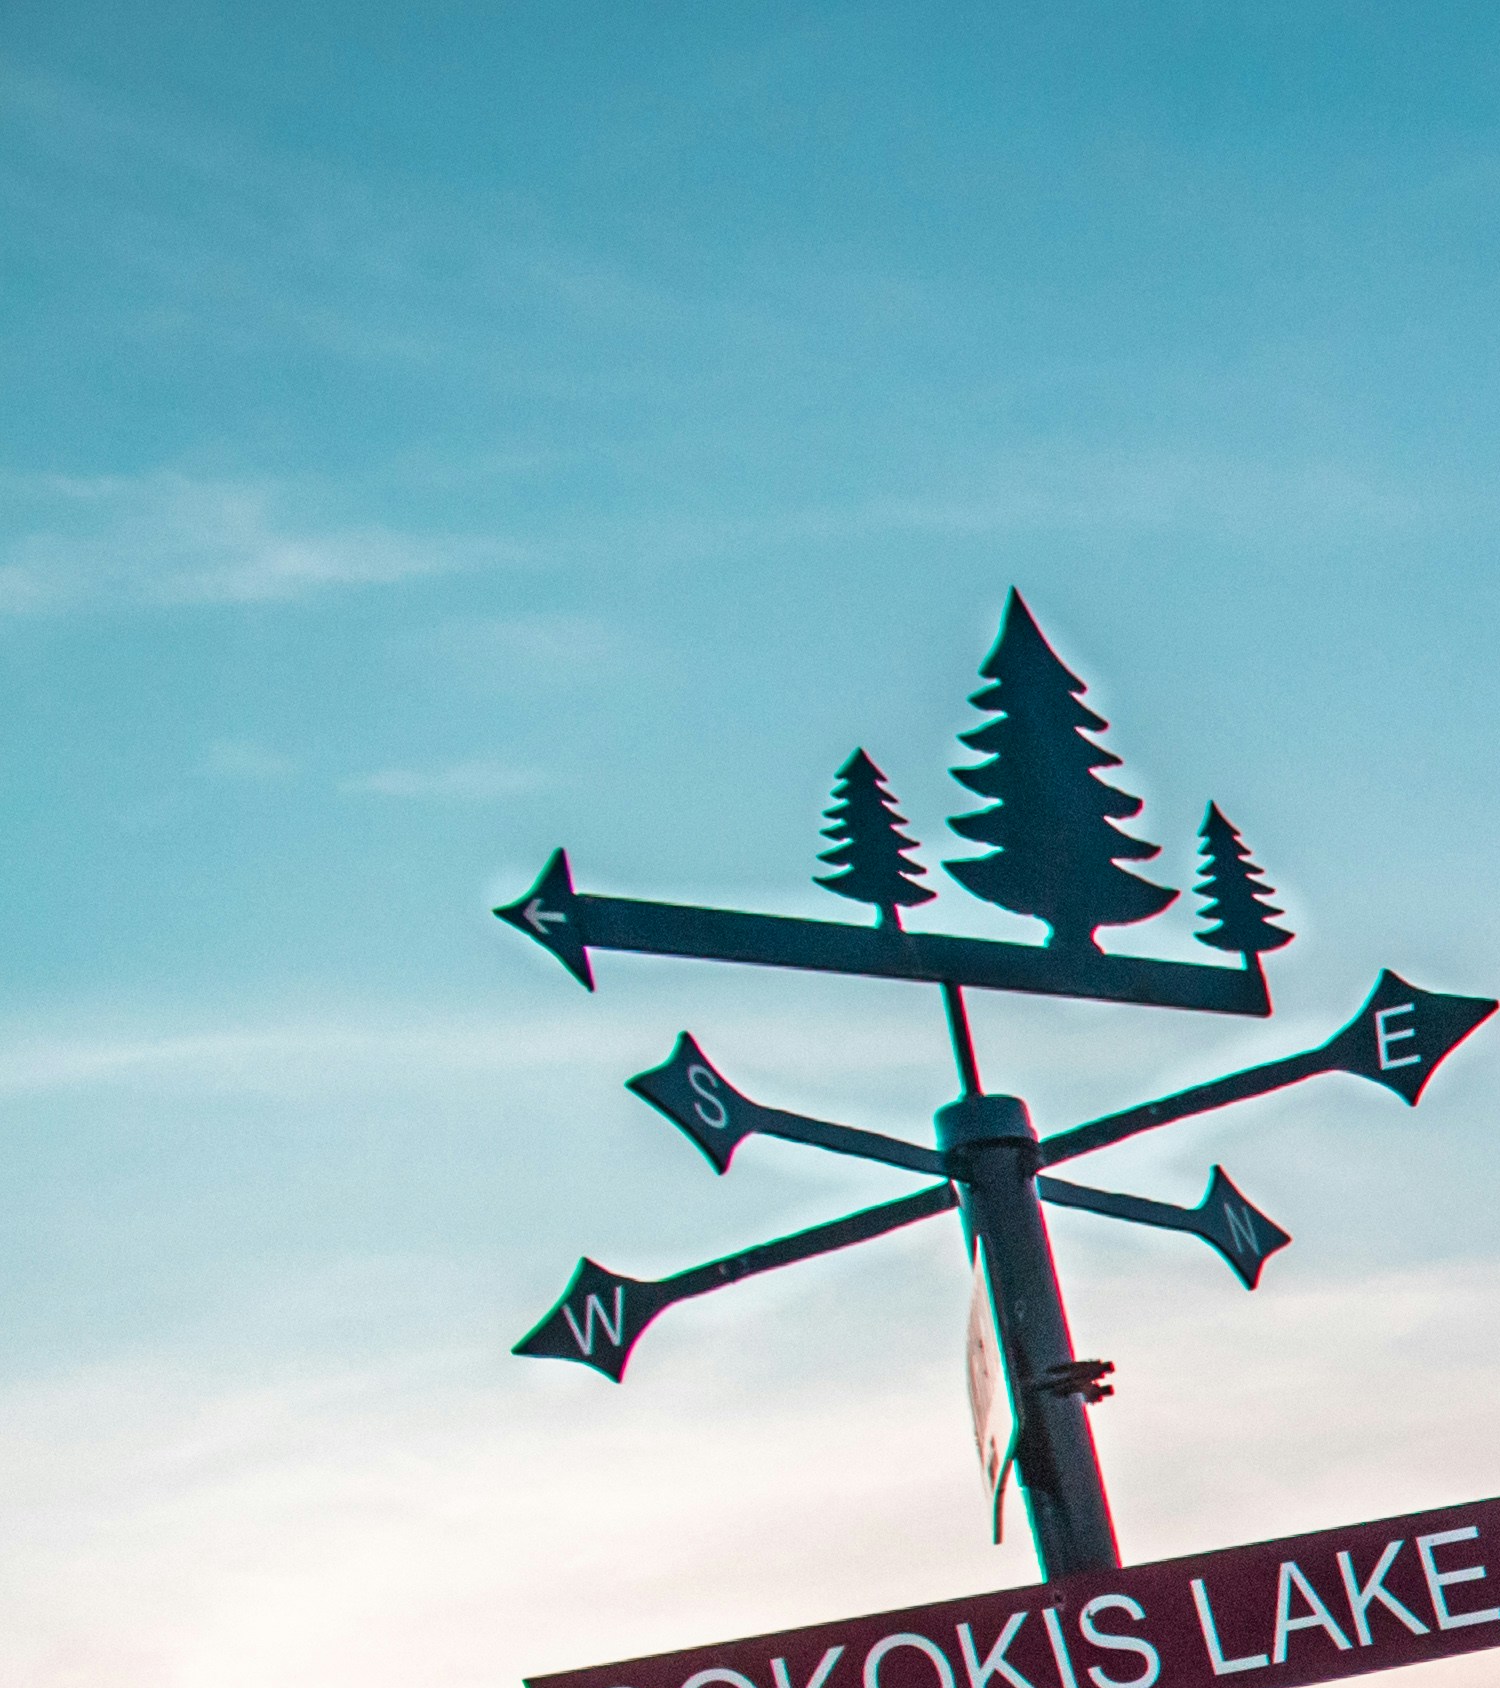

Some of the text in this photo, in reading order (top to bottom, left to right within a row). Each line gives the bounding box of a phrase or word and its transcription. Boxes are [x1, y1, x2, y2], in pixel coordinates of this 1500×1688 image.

[1375, 1002, 1421, 1070] E
[687, 1064, 727, 1129] S
[1223, 1202, 1260, 1255] N
[562, 1285, 625, 1356] W
